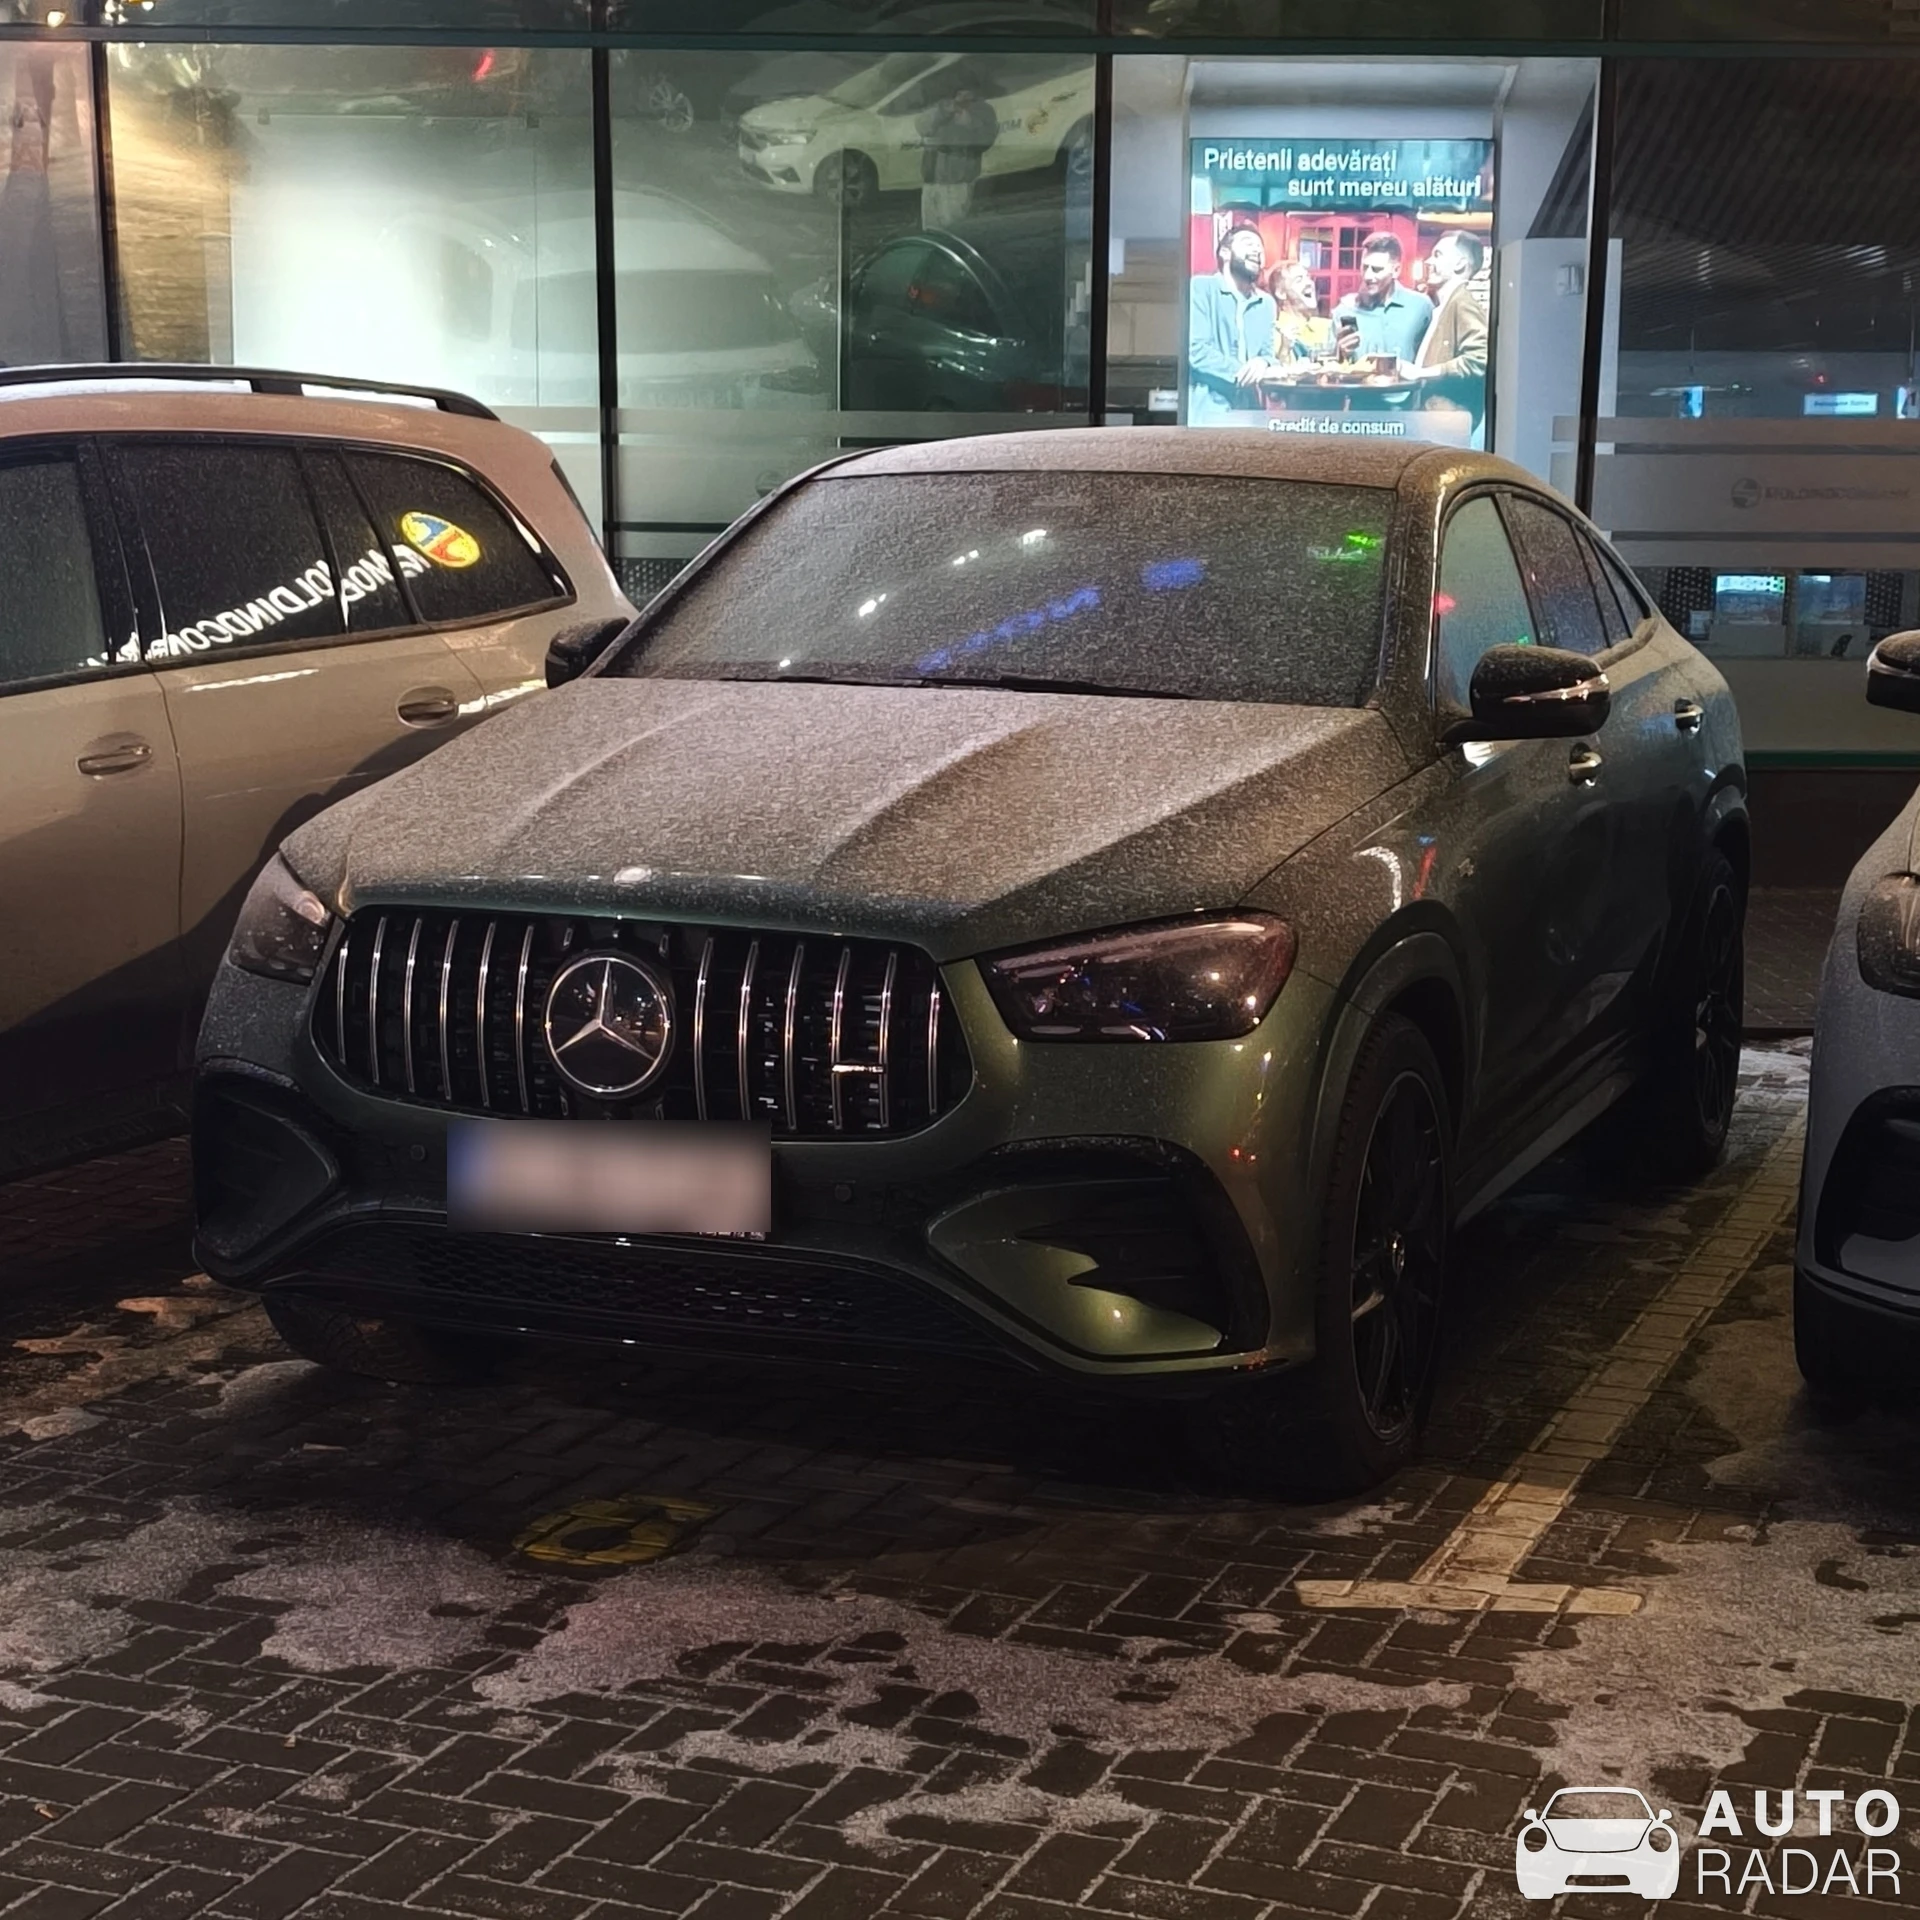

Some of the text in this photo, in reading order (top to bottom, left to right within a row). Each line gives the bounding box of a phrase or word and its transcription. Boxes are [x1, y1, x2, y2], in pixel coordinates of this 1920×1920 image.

[1204, 148, 1292, 171] Prietenii
[1288, 174, 1482, 199] sunt mereu alături
[1268, 415, 1405, 436] Credit de consum
